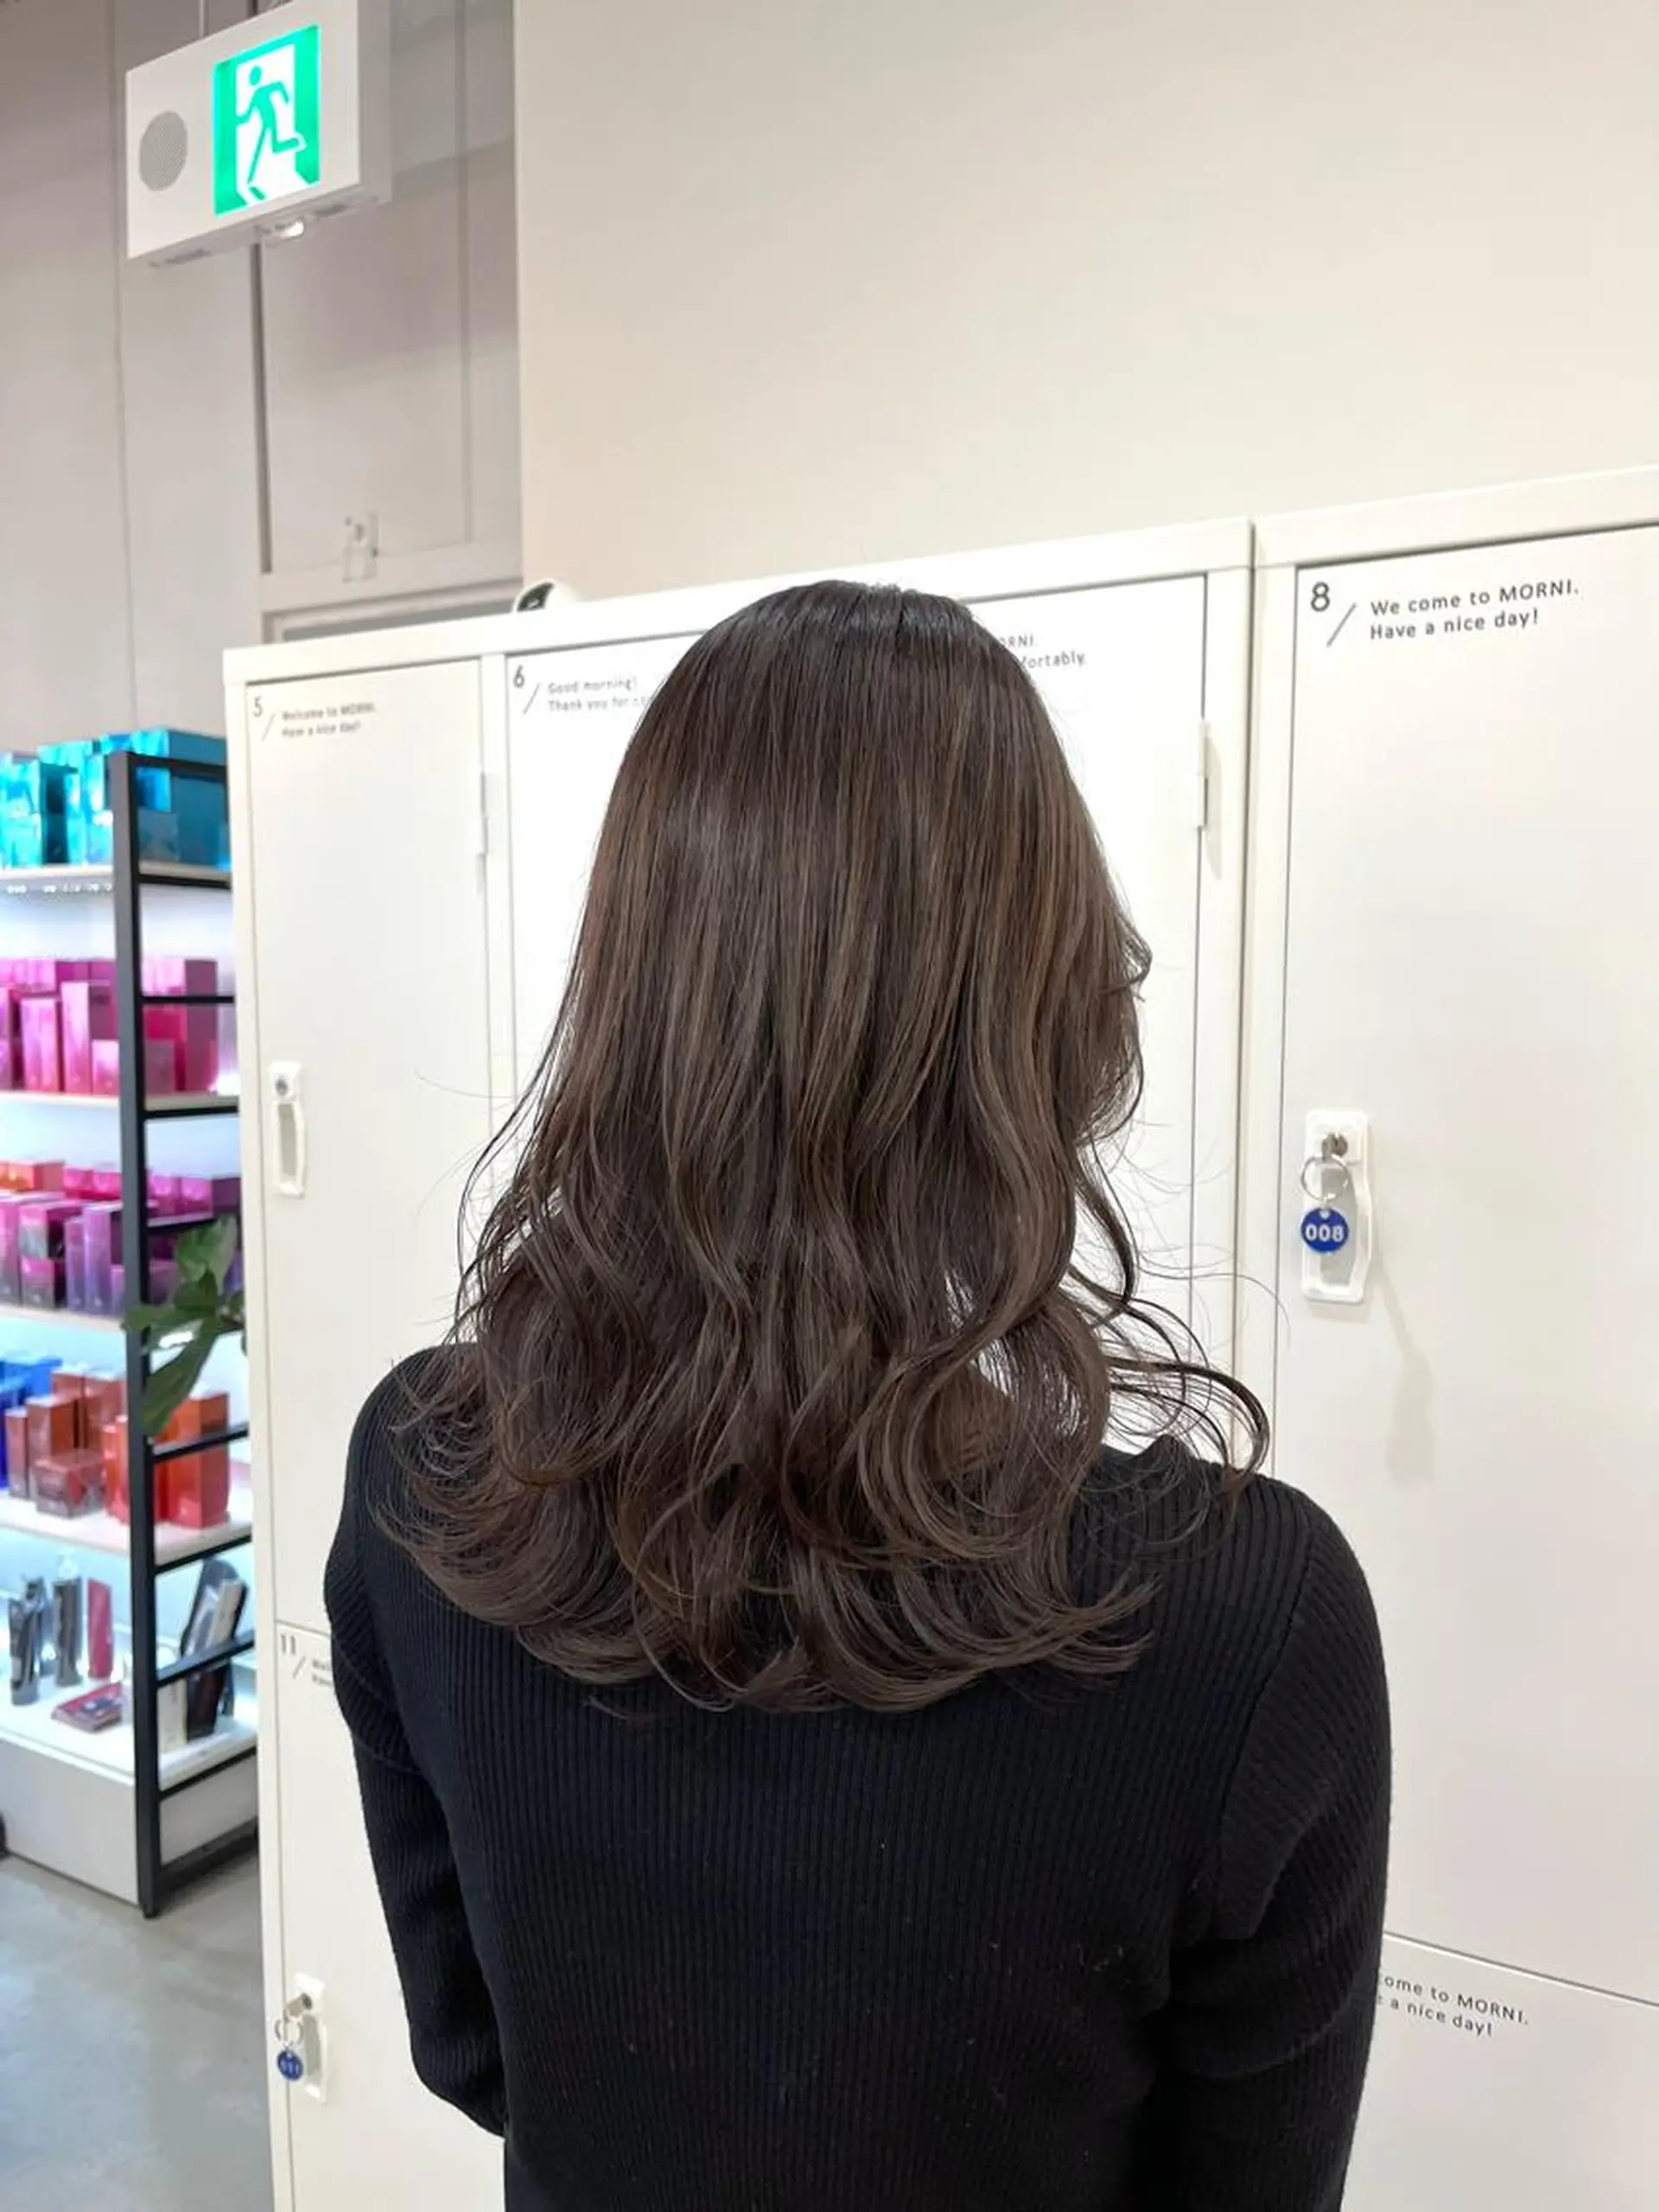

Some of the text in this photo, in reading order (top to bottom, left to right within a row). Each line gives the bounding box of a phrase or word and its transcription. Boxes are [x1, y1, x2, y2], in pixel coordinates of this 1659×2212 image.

[1310, 582, 1331, 613] 8
[1408, 594, 1461, 614] come
[1470, 592, 1491, 607] to
[1499, 579, 1580, 604] MORNI.
[1370, 607, 1540, 641] Have a nice day!
[513, 664, 525, 688] 6
[253, 696, 264, 717] 5
[1305, 1224, 1344, 1243] 008
[1390, 1998, 1399, 2010] a
[1408, 2003, 1446, 2024] nice
[1452, 2014, 1493, 2037] day!
[1431, 1986, 1450, 2003] to
[1457, 1993, 1529, 2025] MORNI.
